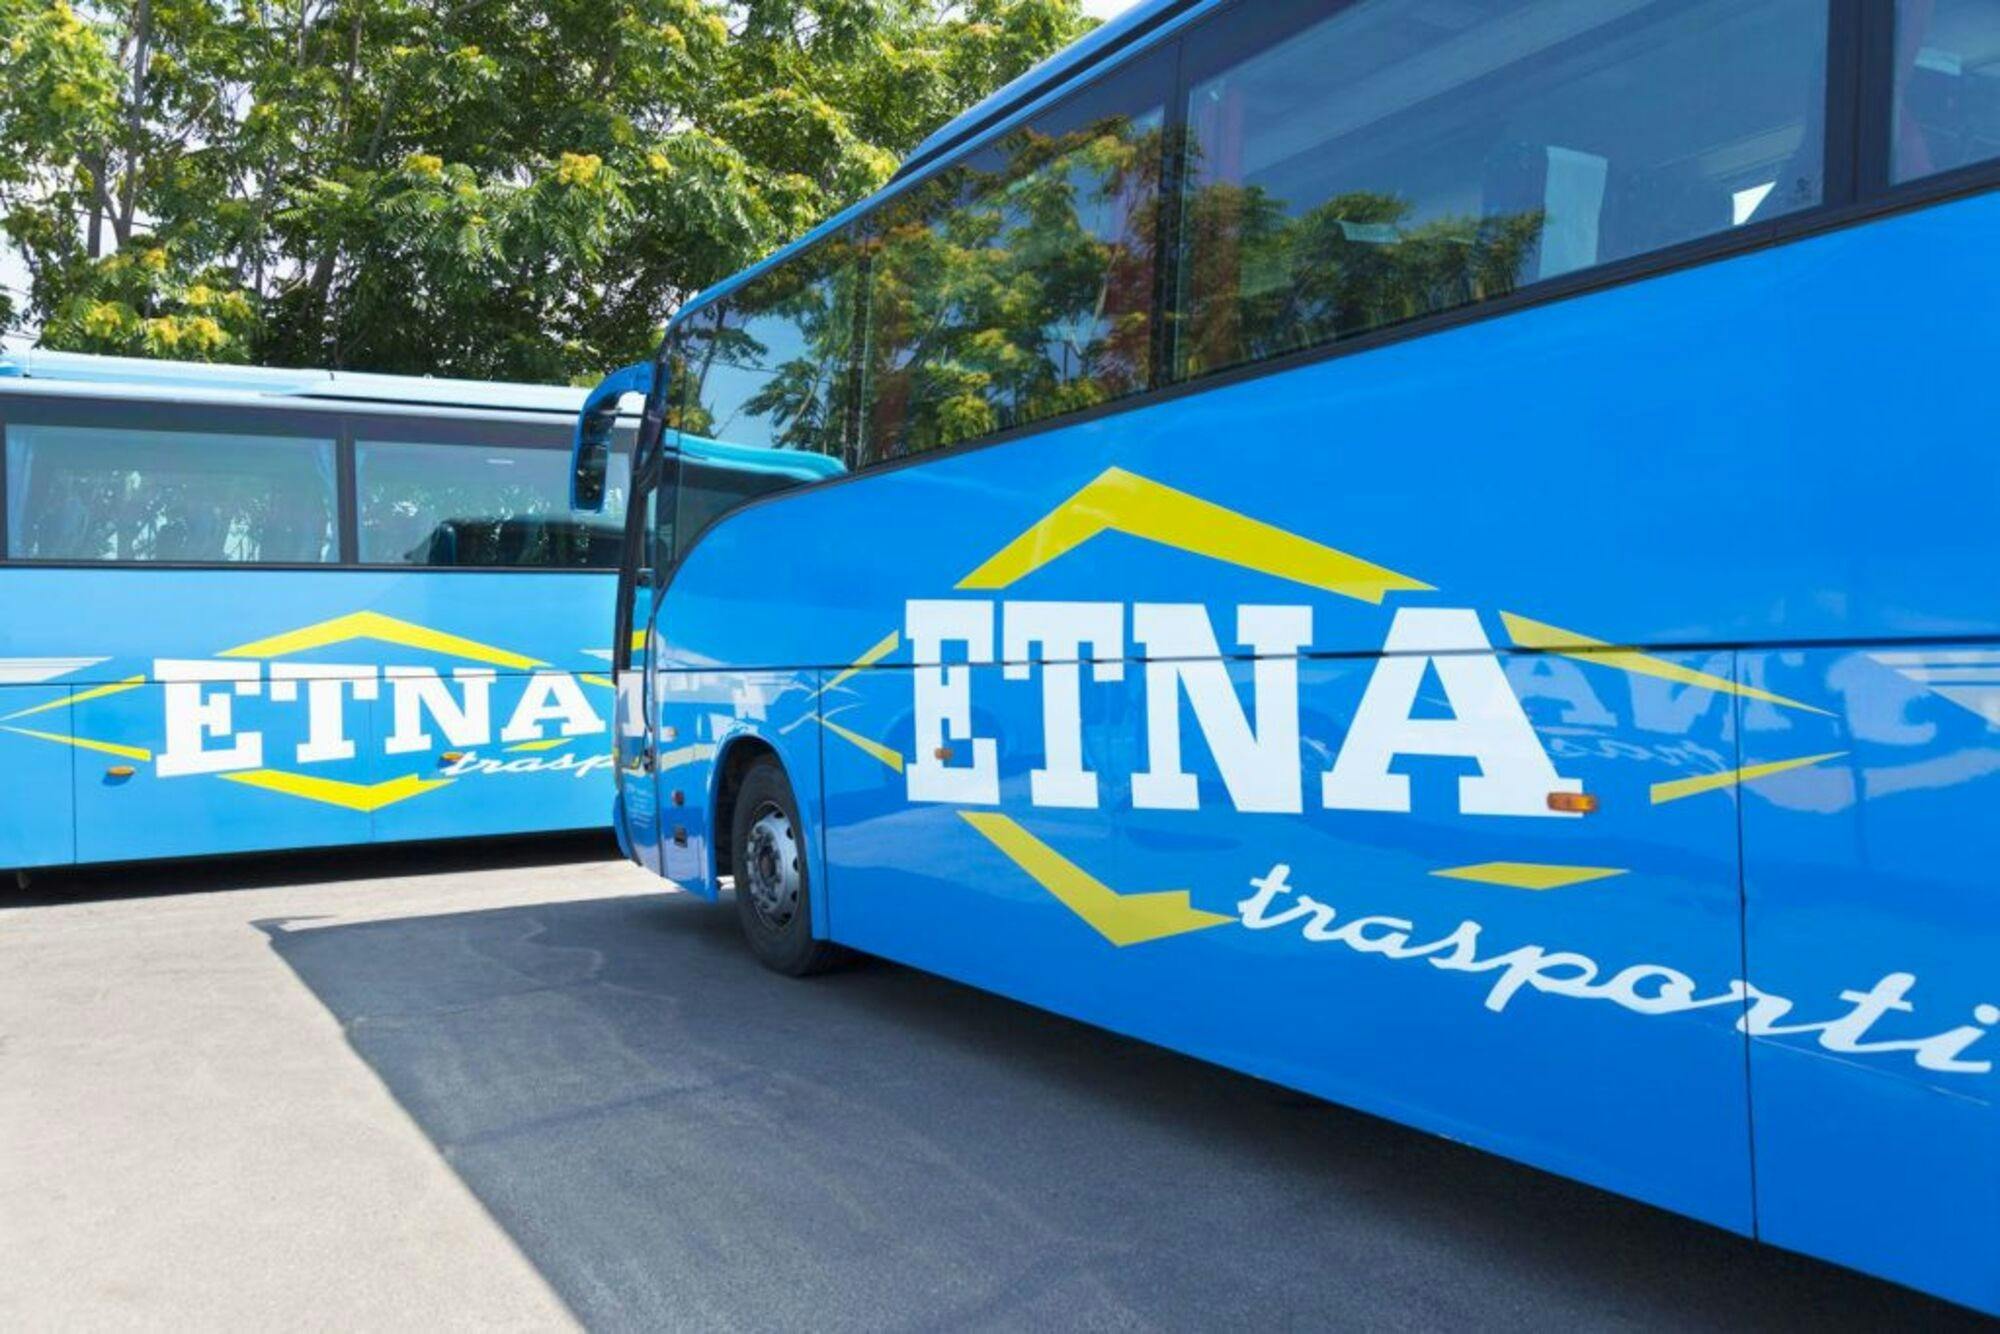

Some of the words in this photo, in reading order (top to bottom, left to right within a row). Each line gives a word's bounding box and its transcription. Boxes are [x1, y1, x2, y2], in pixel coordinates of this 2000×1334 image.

[153, 657, 606, 778] ETNA
[905, 599, 1584, 818] ETNA
[1237, 863, 1999, 1073] trasporti
